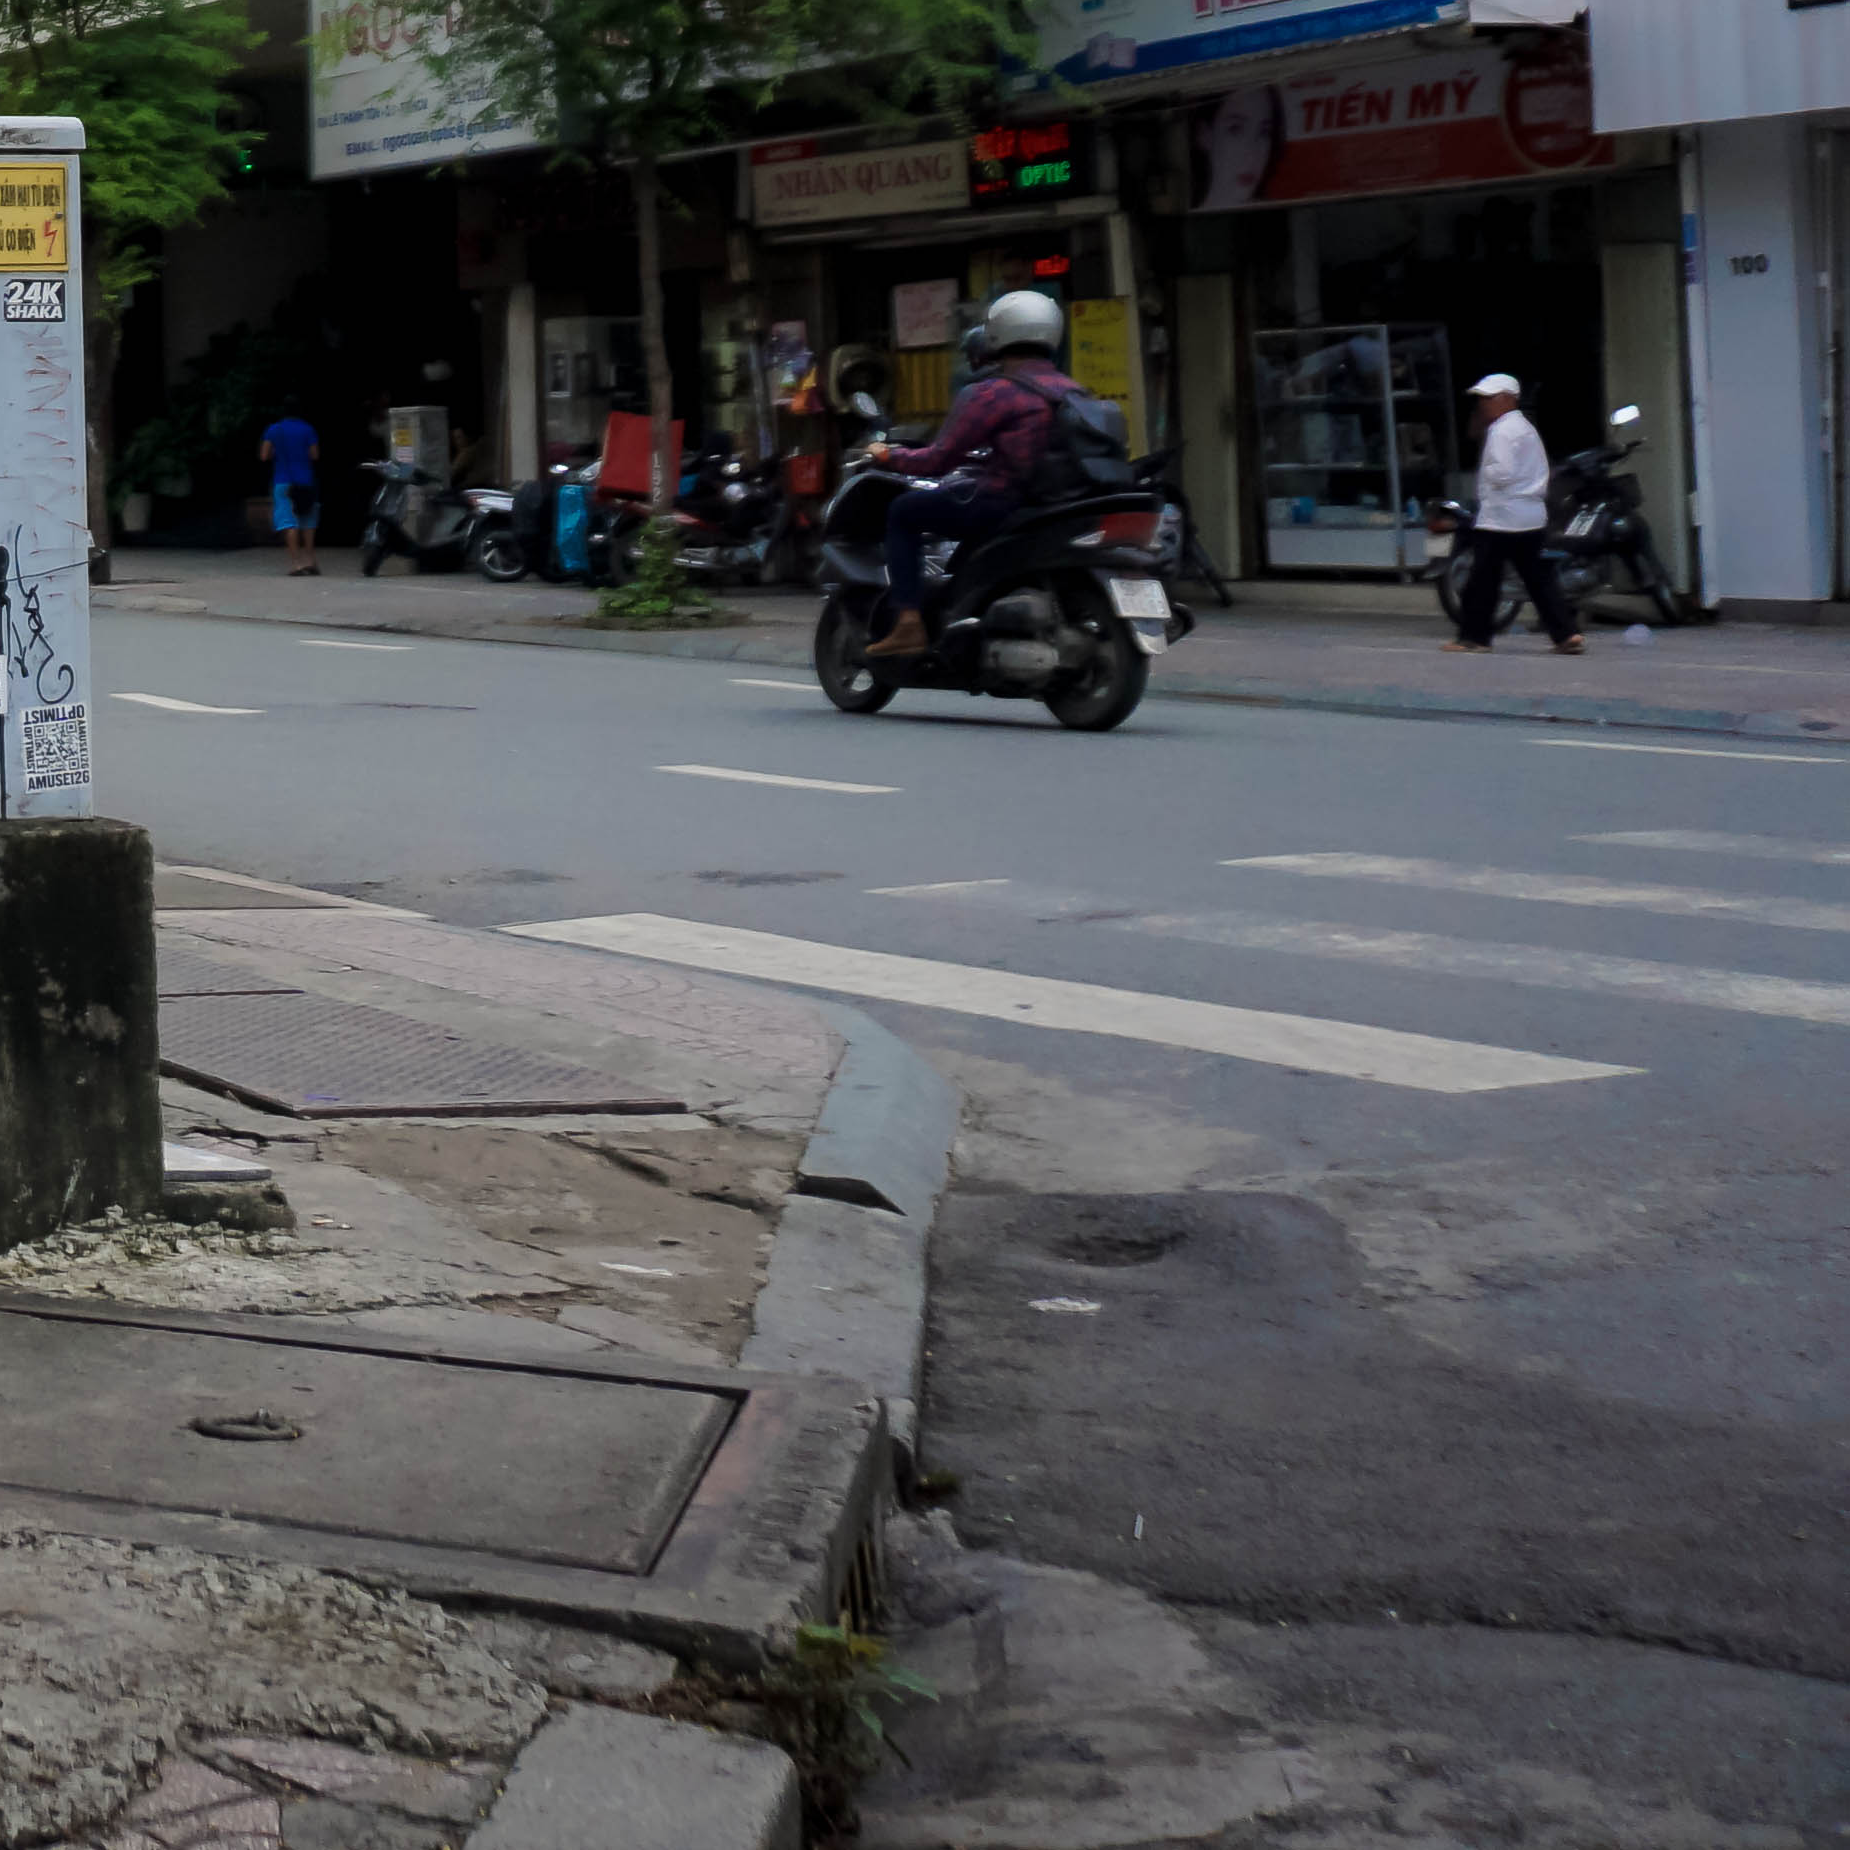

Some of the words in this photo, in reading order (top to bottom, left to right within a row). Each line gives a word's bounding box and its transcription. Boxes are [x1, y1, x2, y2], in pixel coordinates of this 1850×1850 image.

[1303, 81, 1393, 133] TIẾN
[1730, 253, 1770, 276] 100
[8, 281, 63, 305] 24K
[6, 305, 63, 319] SHAKA
[23, 704, 85, 725] OPTIMIST
